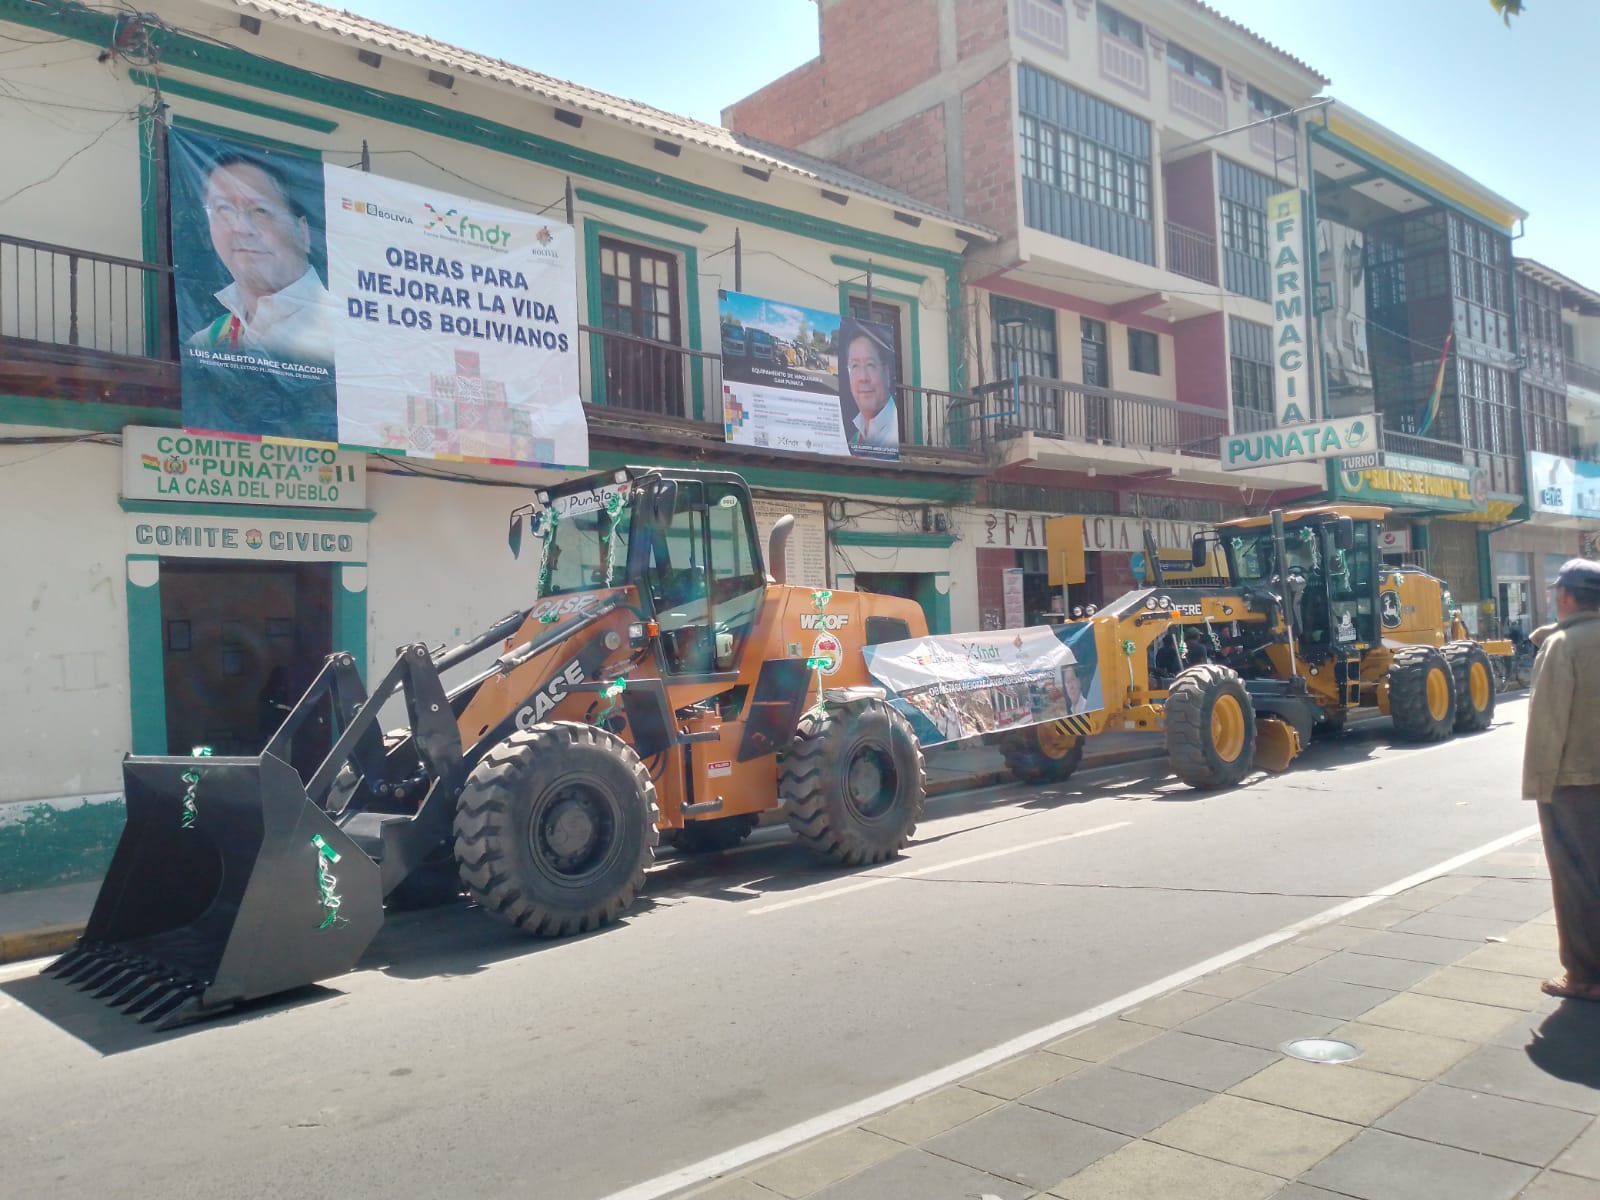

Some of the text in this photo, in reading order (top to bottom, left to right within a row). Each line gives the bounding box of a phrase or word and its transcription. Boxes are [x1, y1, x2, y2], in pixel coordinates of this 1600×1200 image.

[378, 210, 414, 224] BOLIVIA
[459, 216, 511, 246] fndr
[386, 247, 528, 290] OBRAS PARA
[358, 270, 559, 324] MEJORAR LA VIDA
[348, 297, 569, 352] DE LOS BOLIVIANOS
[1275, 218, 1306, 426] FARMACIA
[190, 348, 328, 376] LUIS ALBERTO ARCE CATACORA
[158, 436, 336, 464] COMITE CIVICO
[1228, 425, 1342, 464] PUNATA
[1342, 455, 1375, 470] TURNO
[158, 477, 339, 502] LA CASA DEL PUEBLO
[136, 524, 352, 552] COMITE CIVICO
[531, 594, 600, 618] CASE
[514, 659, 586, 730] CASE
